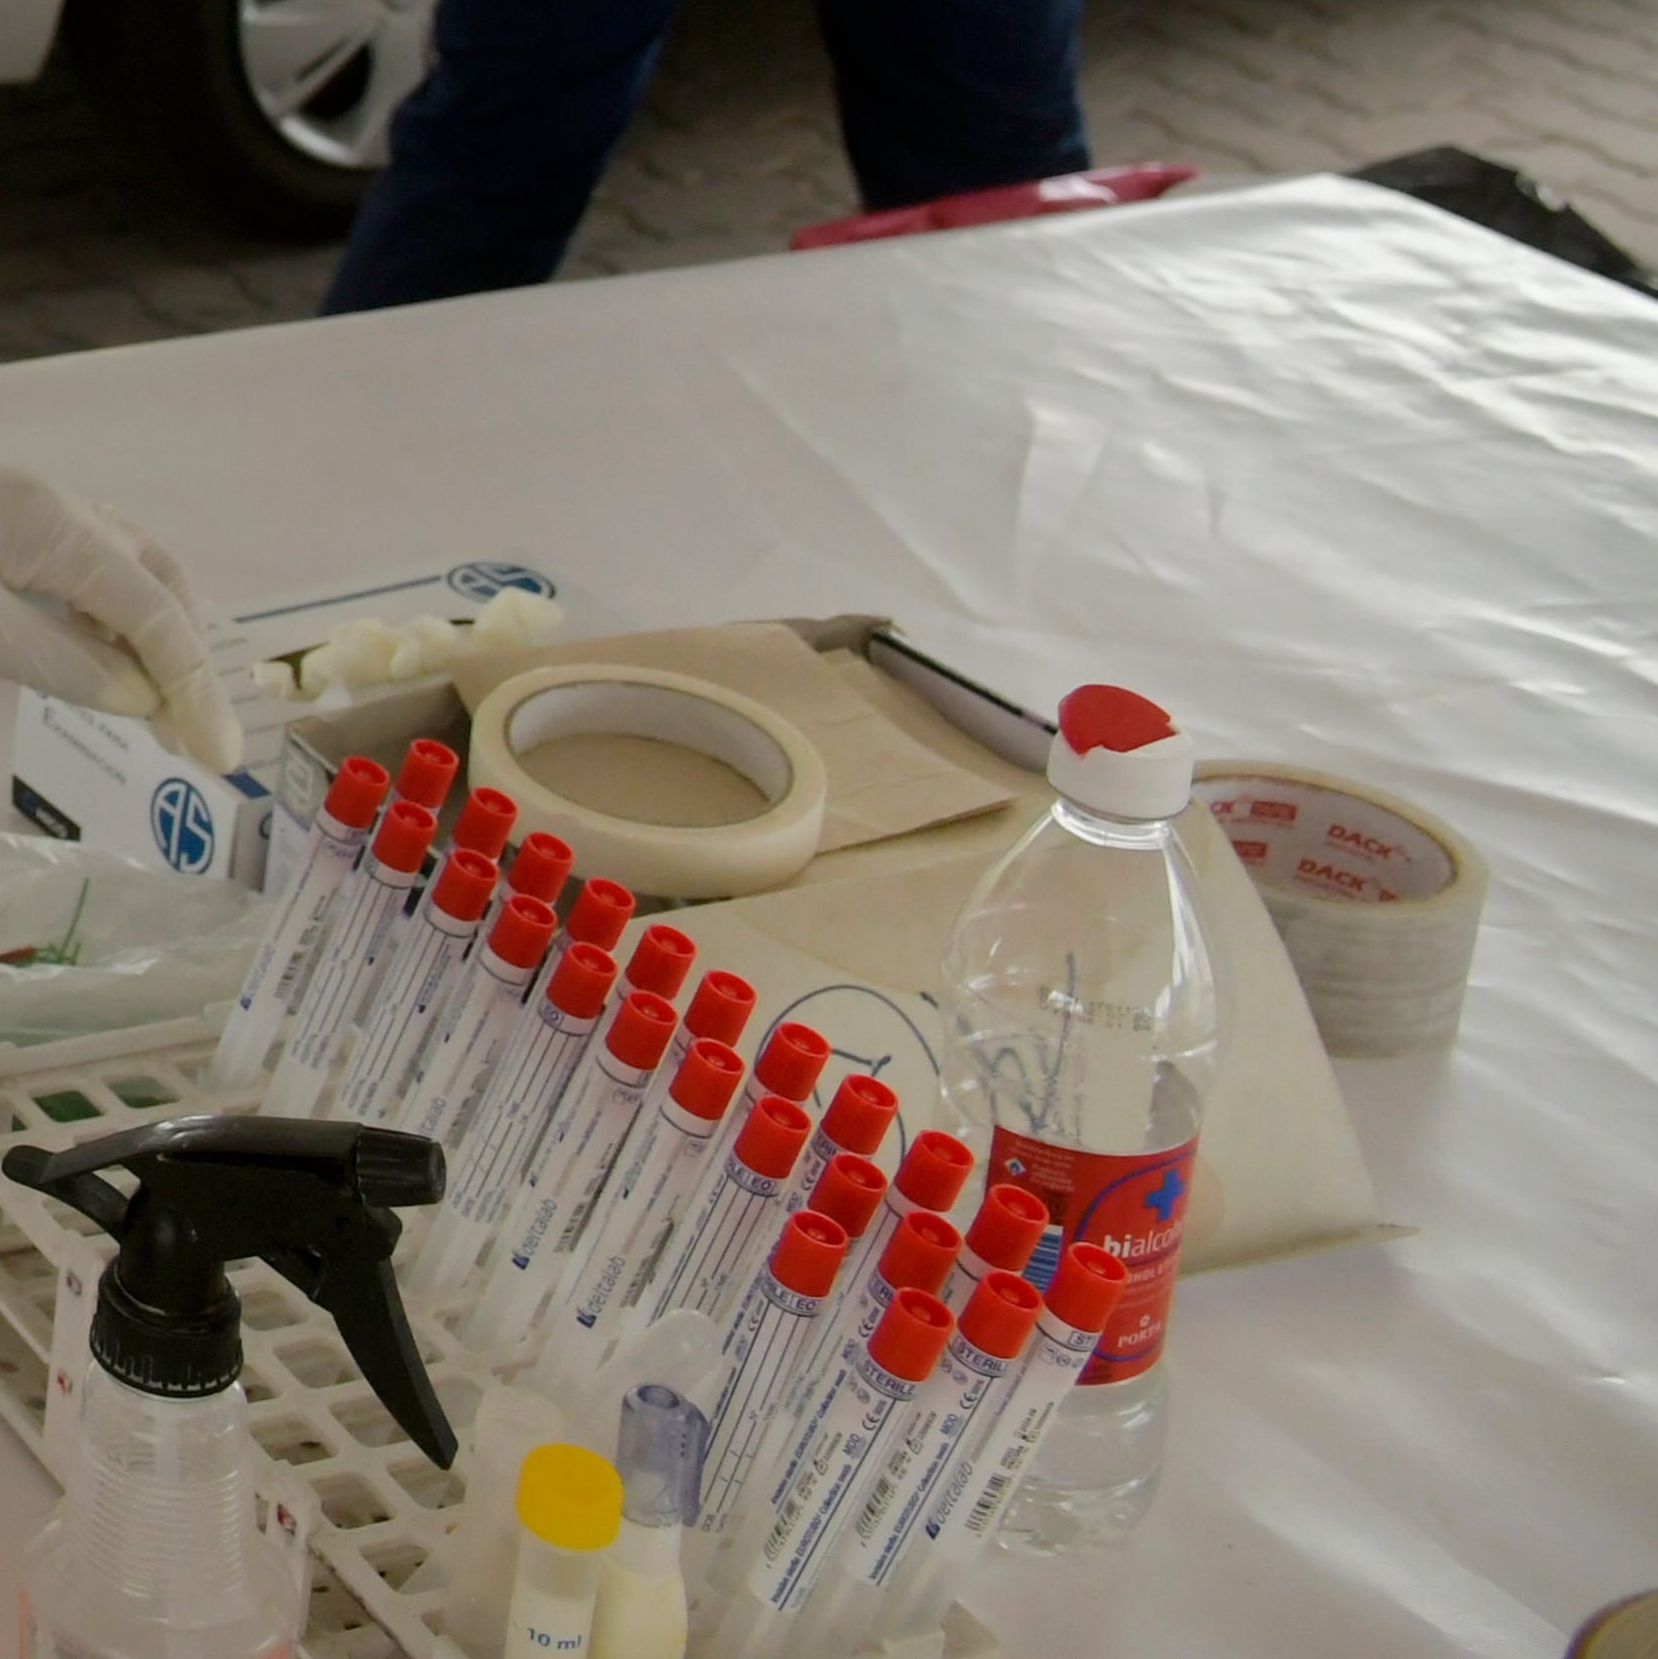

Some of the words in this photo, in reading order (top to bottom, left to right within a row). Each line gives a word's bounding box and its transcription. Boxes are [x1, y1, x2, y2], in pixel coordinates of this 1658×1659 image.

[154, 782, 213, 874] AS
[1328, 825, 1394, 859] DACK
[1298, 859, 1365, 891] DACK
[522, 1198, 557, 1257] deltalab
[589, 1255, 626, 1314] deltalab
[939, 1461, 974, 1525] deltalab
[527, 1628, 551, 1647] 10
[557, 1634, 582, 1650] ml
